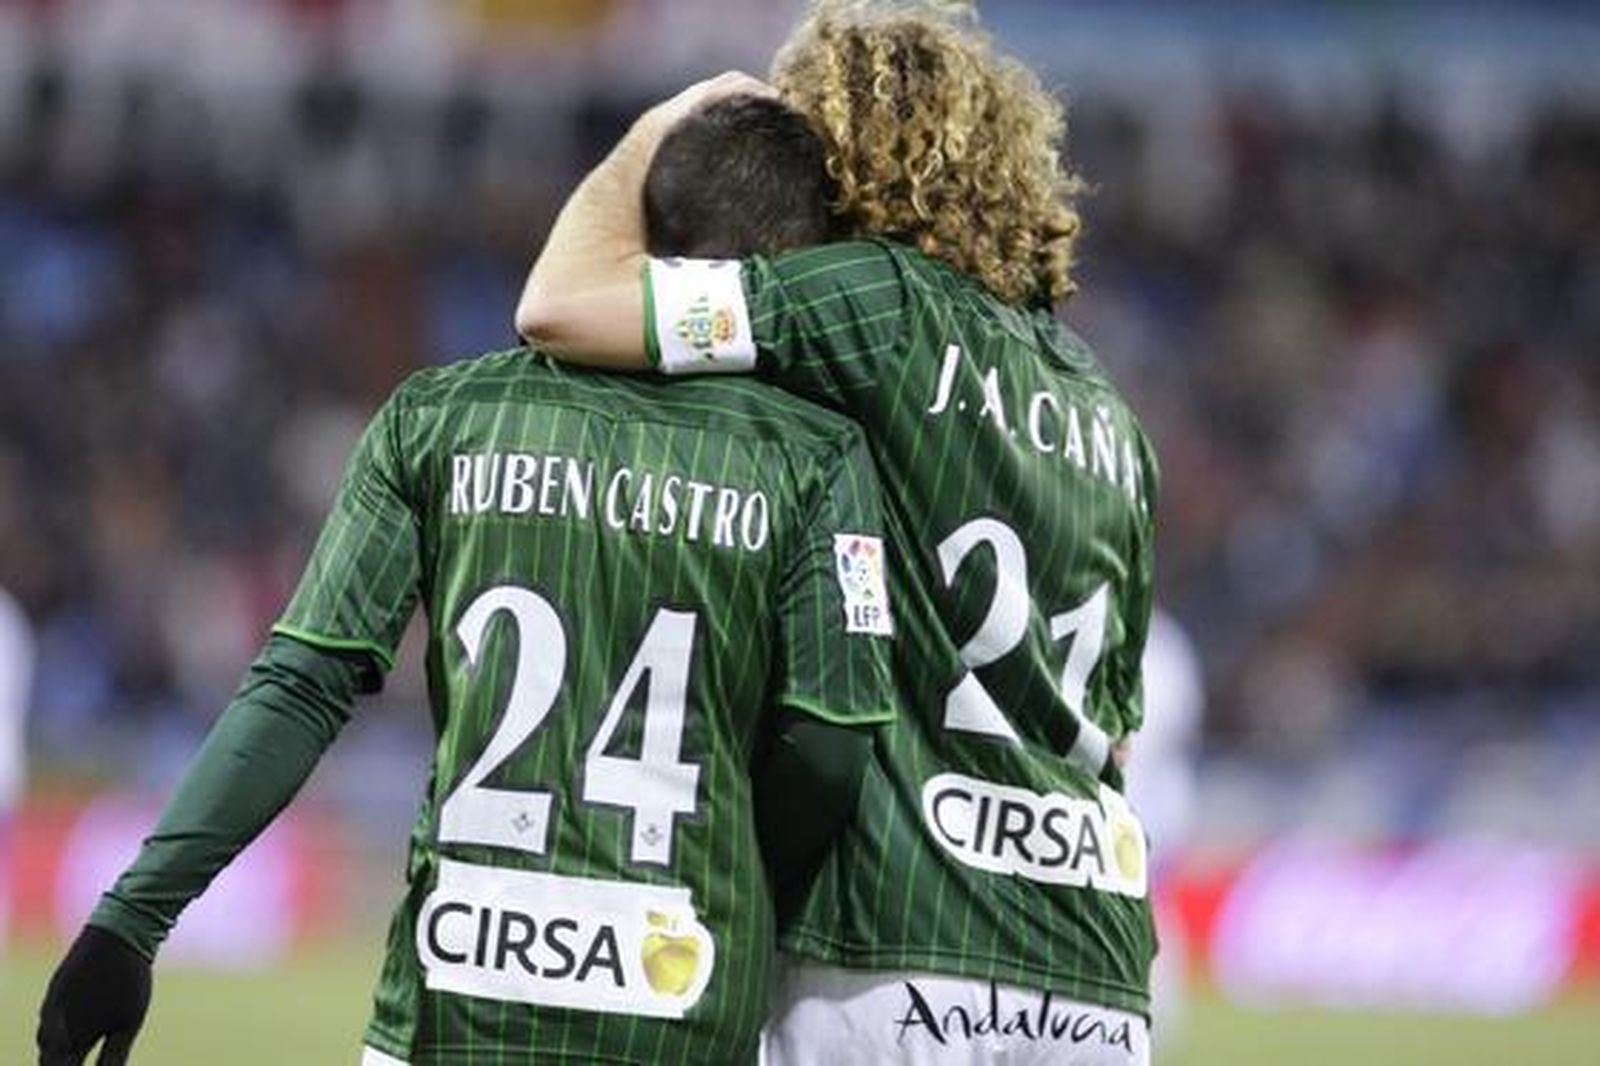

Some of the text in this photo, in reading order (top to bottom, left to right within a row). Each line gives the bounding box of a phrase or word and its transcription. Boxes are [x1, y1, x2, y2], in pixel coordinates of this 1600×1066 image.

[450, 452, 769, 551] RUBEN CASTRO
[853, 604, 880, 628] LFP
[937, 516, 1109, 780] 21
[438, 585, 701, 867] 24
[931, 787, 1106, 875] CIRSA
[426, 900, 627, 988] CIRSA
